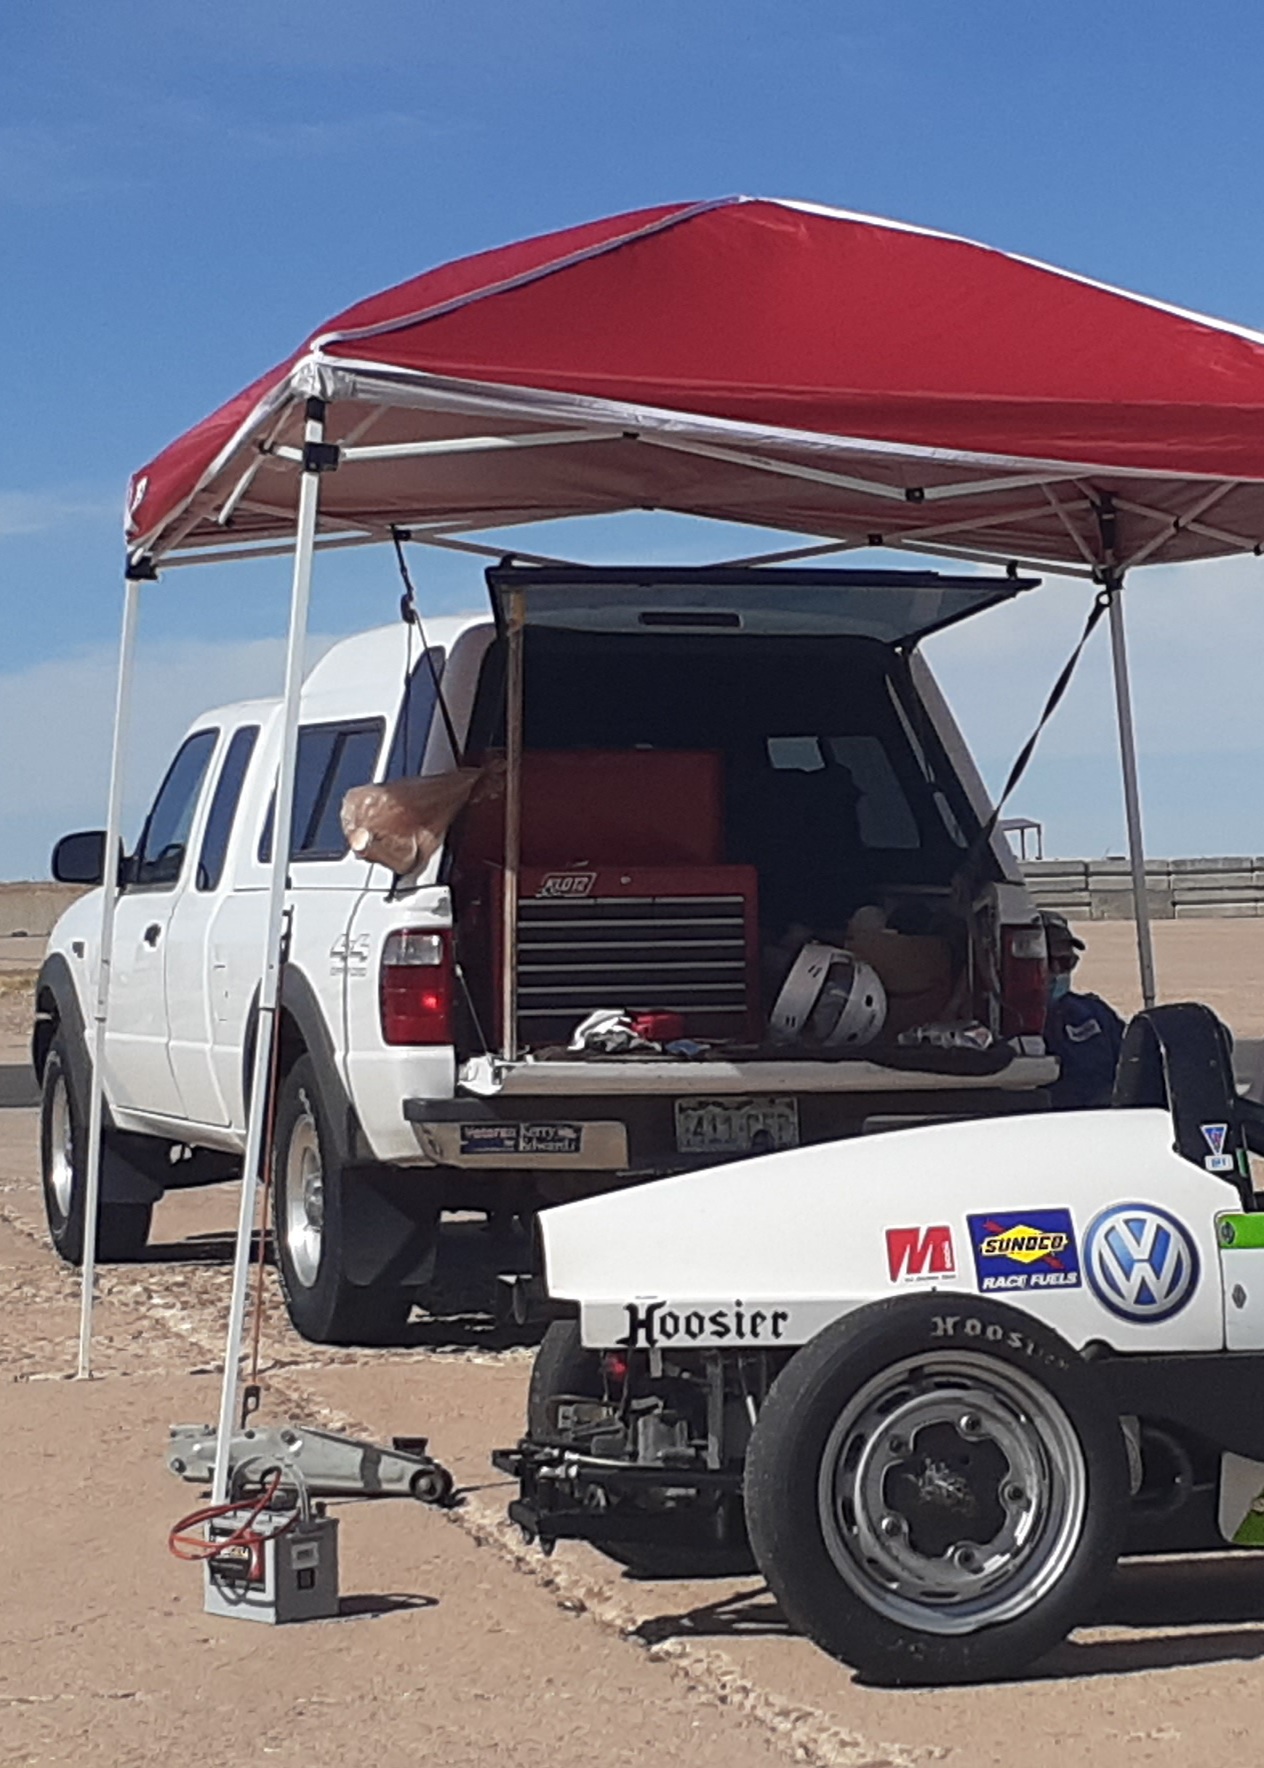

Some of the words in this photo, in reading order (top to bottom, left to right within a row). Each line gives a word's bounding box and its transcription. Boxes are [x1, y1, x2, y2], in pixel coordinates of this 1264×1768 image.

[984, 1235, 1064, 1253] SUNOCO
[982, 1274, 1027, 1290] RACE
[1030, 1271, 1078, 1287] FUELS
[615, 1299, 789, 1348] Hoosier
